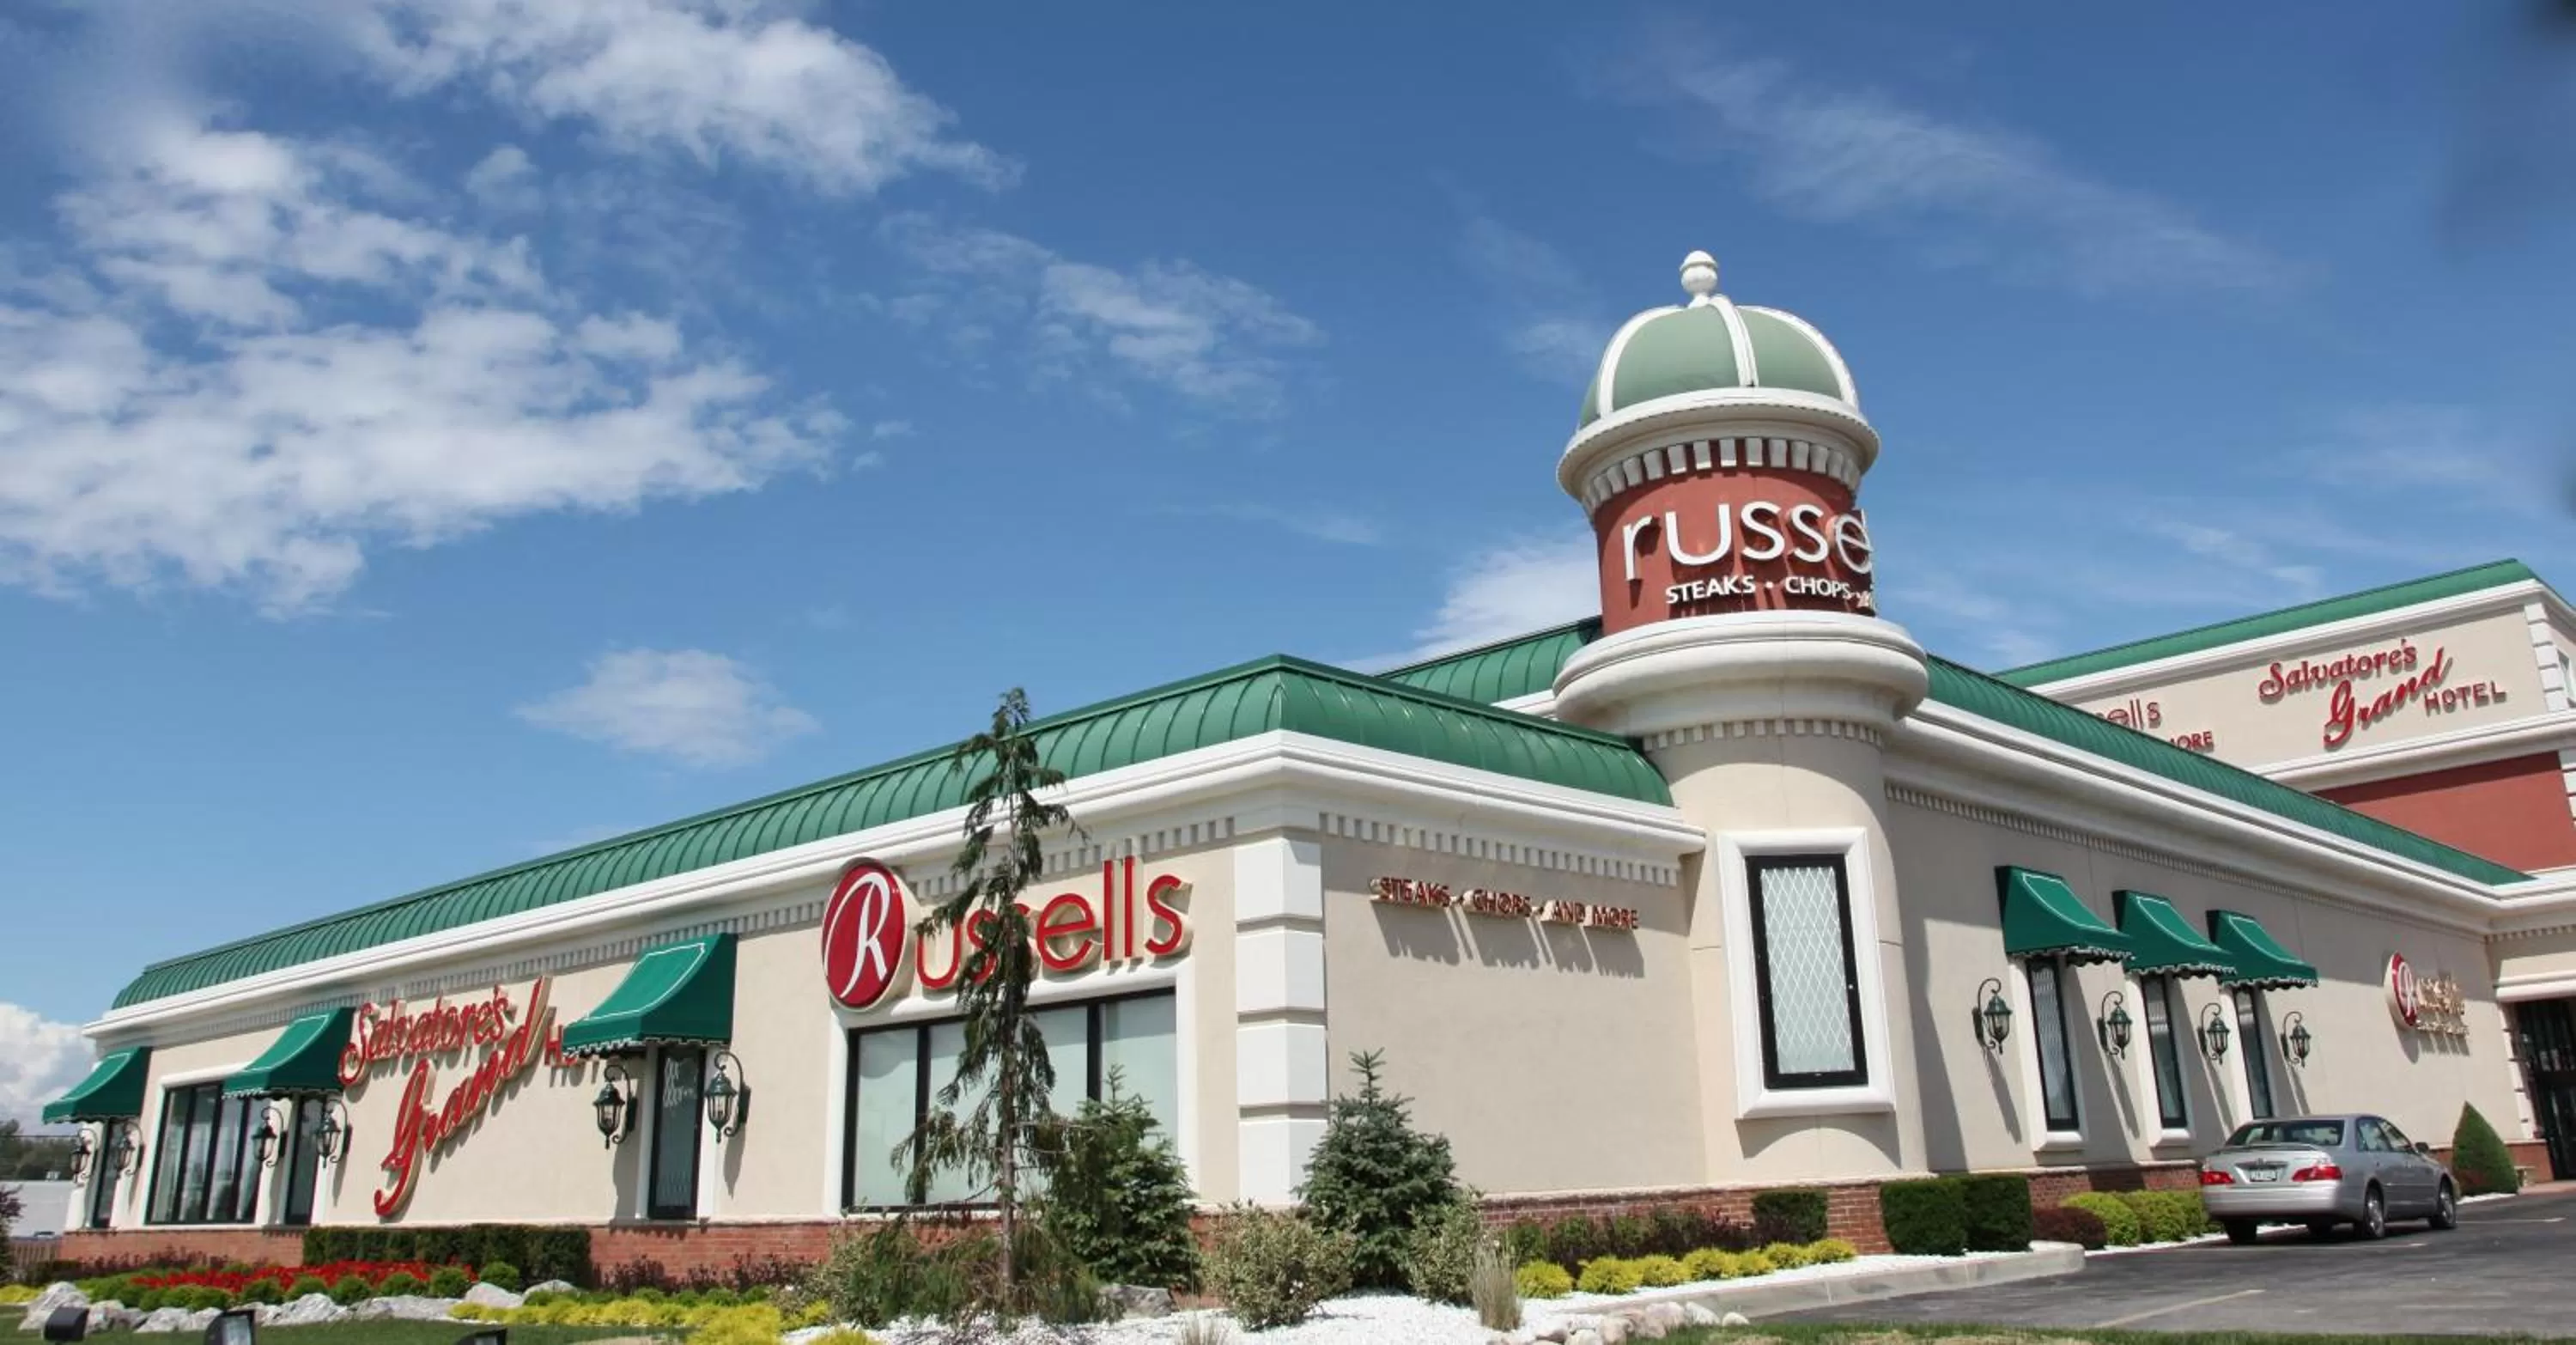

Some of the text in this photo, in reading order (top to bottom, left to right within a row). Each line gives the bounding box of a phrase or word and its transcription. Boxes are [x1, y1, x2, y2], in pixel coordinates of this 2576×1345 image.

[1666, 575, 1756, 604] STEAKS
[1784, 575, 1851, 599] CHOPS
[2258, 638, 2417, 698] Salvatore's
[2323, 646, 2507, 746] Grand HOTEL
[2169, 731, 2213, 752] ORE
[1376, 876, 1638, 930] STEAKS CHOPS AND MORE
[338, 984, 510, 1086] Salvatore's
[373, 976, 544, 1217] Grand
